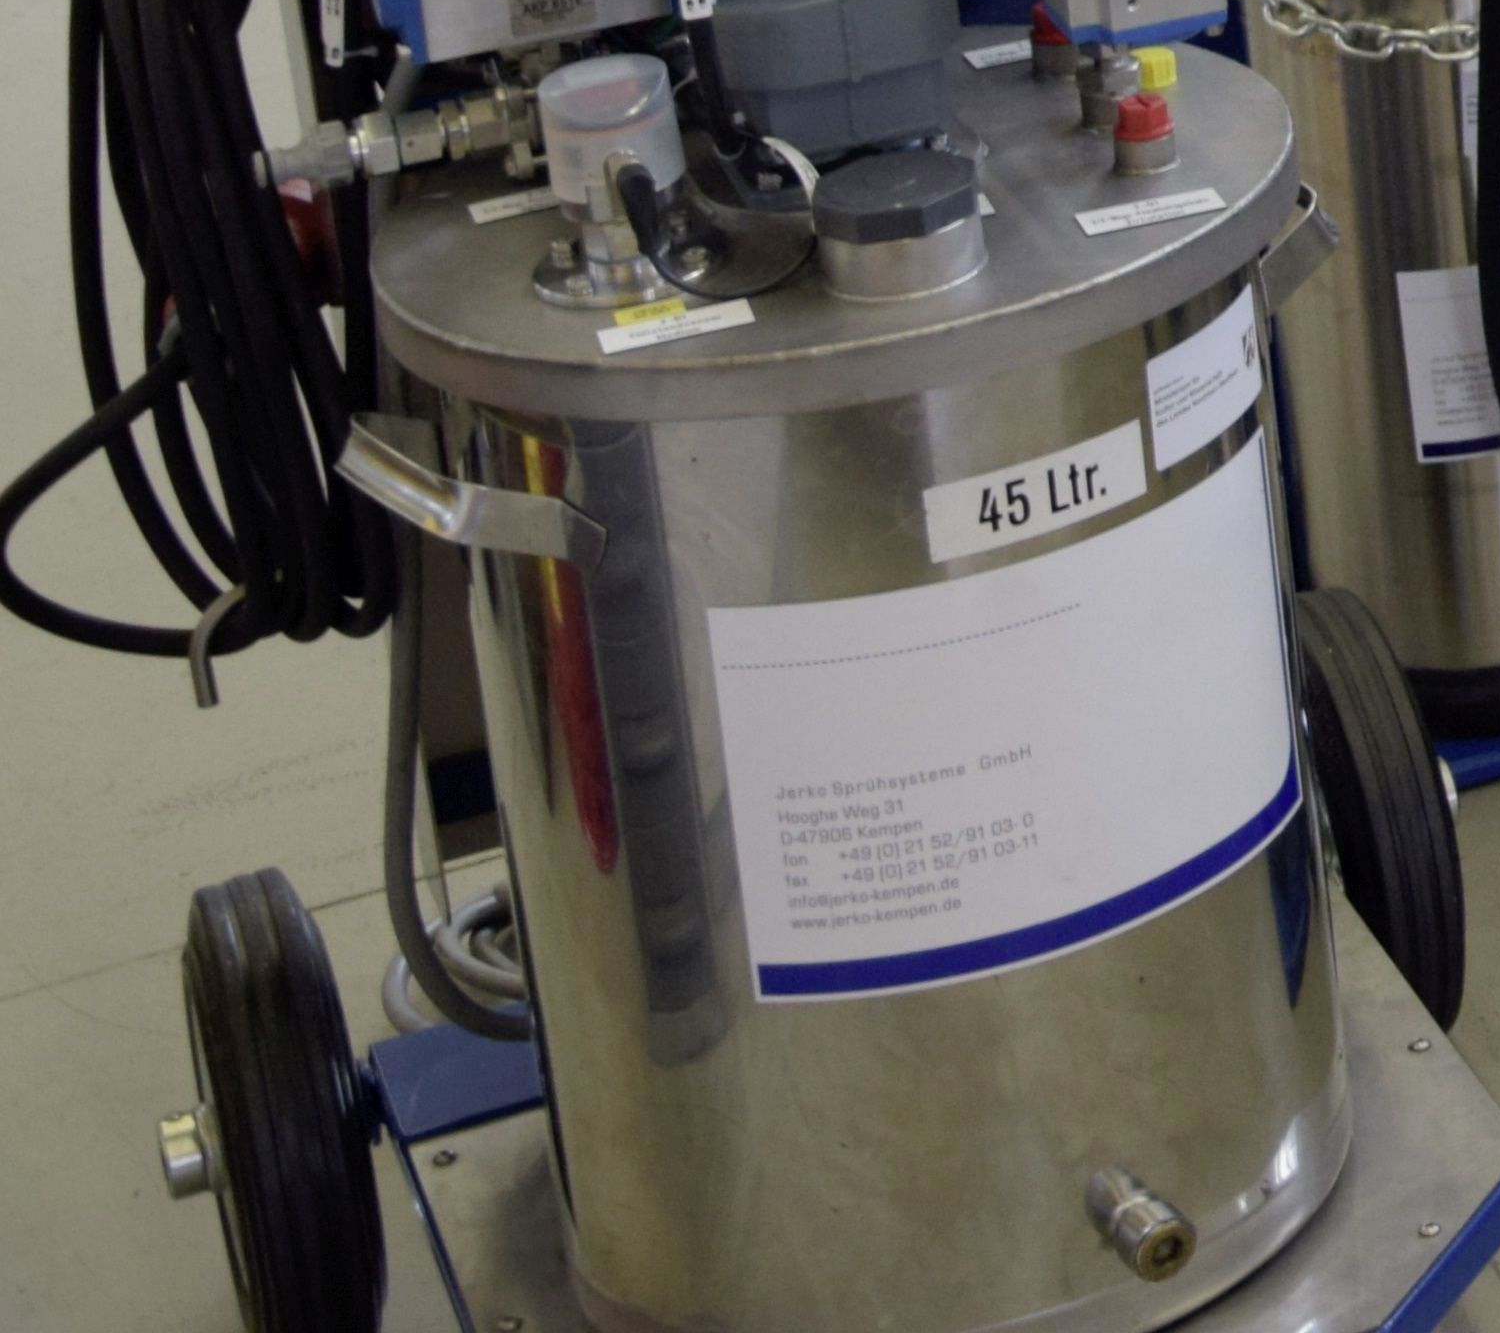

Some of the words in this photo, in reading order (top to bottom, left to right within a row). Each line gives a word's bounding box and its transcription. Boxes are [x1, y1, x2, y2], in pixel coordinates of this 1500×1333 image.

[978, 477, 1031, 533] 45
[1047, 462, 1107, 515] Ltr.
[775, 785, 827, 801] Jerko
[832, 764, 967, 800] Sprühsysteme
[979, 744, 1032, 771] GmbH
[778, 808, 838, 827] Hooghe
[842, 804, 880, 820] Weg
[884, 799, 904, 816] 31
[781, 826, 853, 847] D-47906
[857, 819, 923, 842] Kempen
[783, 852, 808, 867] fon
[839, 846, 872, 862] +49
[876, 842, 900, 862] (0)
[904, 838, 924, 855] 21
[931, 824, 985, 849] 52/91
[785, 874, 809, 888] fax
[842, 867, 874, 884] +49
[879, 863, 903, 882] (0)
[907, 858, 927, 876] 21
[933, 846, 988, 872] 52/91
[994, 833, 1039, 857] 03-11
[788, 877, 960, 910] info@jerko-kempen.de
[791, 897, 962, 931] www.jerko-kempen.de
